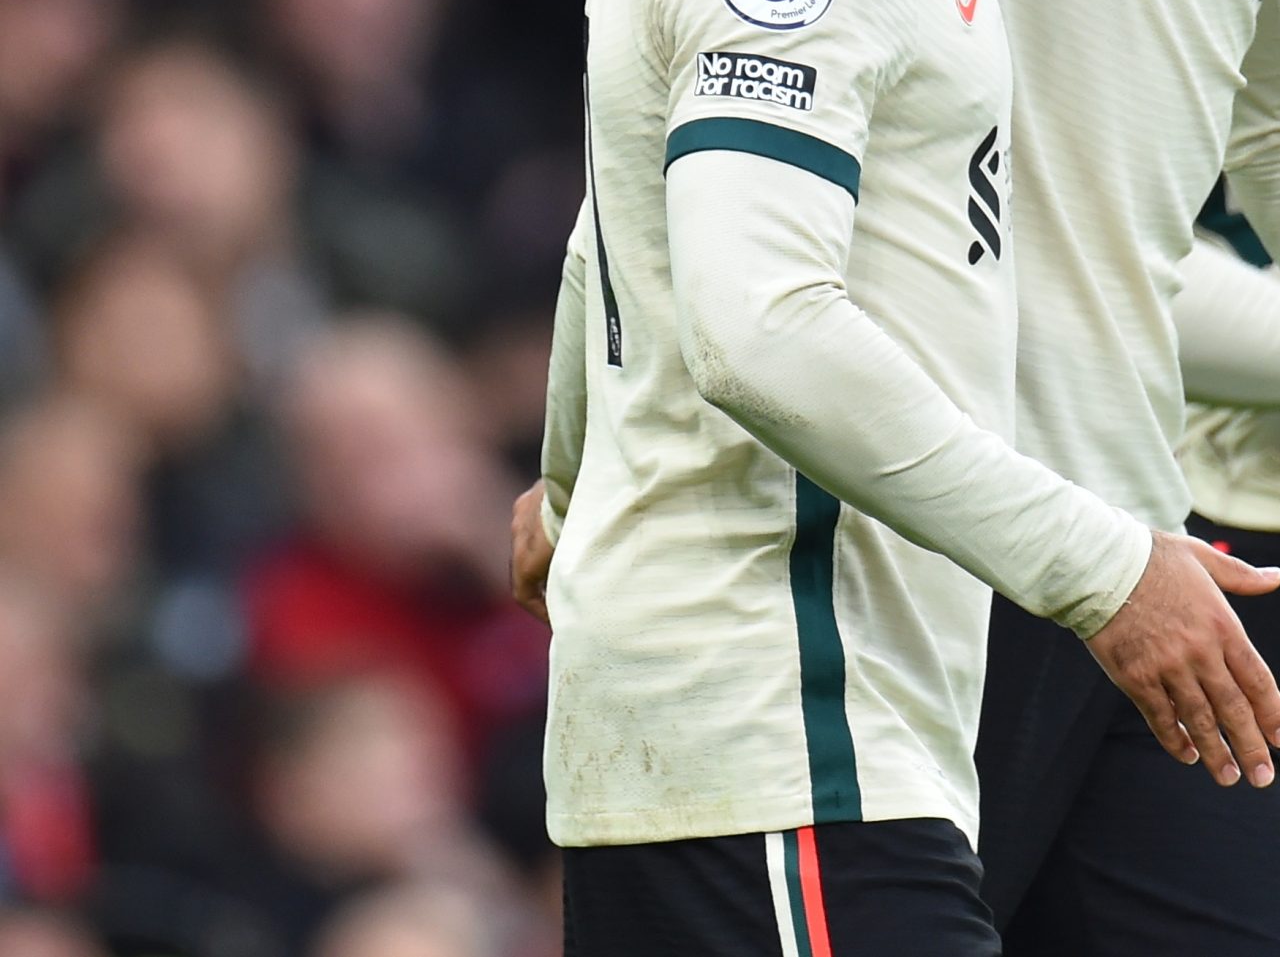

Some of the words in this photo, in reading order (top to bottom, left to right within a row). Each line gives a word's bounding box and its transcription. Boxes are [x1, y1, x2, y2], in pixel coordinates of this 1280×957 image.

[770, 8, 807, 19] Premier
[698, 53, 732, 76] No
[735, 58, 804, 89] room
[695, 73, 729, 95] for
[730, 77, 812, 111] racism
